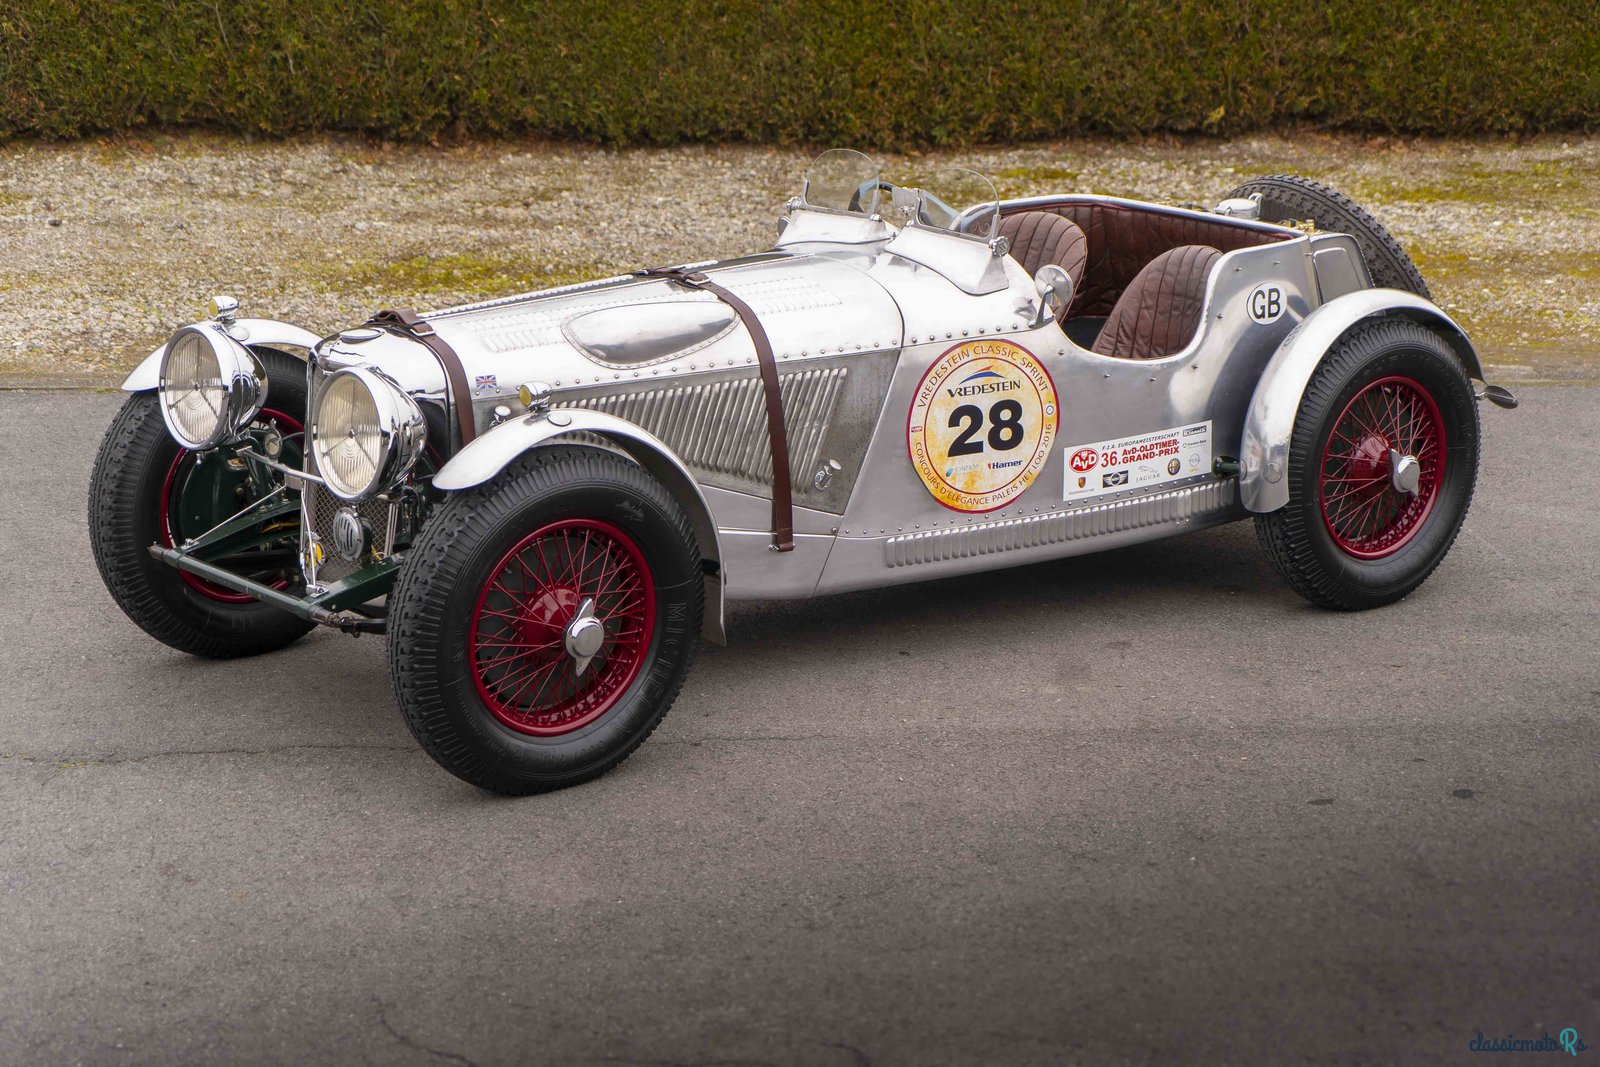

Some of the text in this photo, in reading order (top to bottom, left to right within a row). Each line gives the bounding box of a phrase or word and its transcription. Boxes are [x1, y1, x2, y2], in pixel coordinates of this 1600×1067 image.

[1252, 287, 1280, 319] GB
[917, 345, 1049, 408] VREDESTEIN CLASSIC SPRINT
[947, 379, 1021, 398] VREDESTEIN
[948, 399, 1024, 457] 28
[1117, 431, 1180, 448] EUROPAMEISTERSCHAFT
[1122, 438, 1180, 457] AvD-OLDTIMER-
[915, 442, 940, 489] CONCOURS
[992, 485, 1018, 502] PALEIS
[1019, 468, 1034, 486] HET
[1032, 450, 1045, 469] LOO
[1043, 423, 1052, 449] 2016
[1100, 450, 1121, 468] 36.
[1122, 446, 1180, 464] GRAND-PRIX
[992, 460, 1023, 470] Hamer
[1136, 472, 1161, 482] JAGUAR
